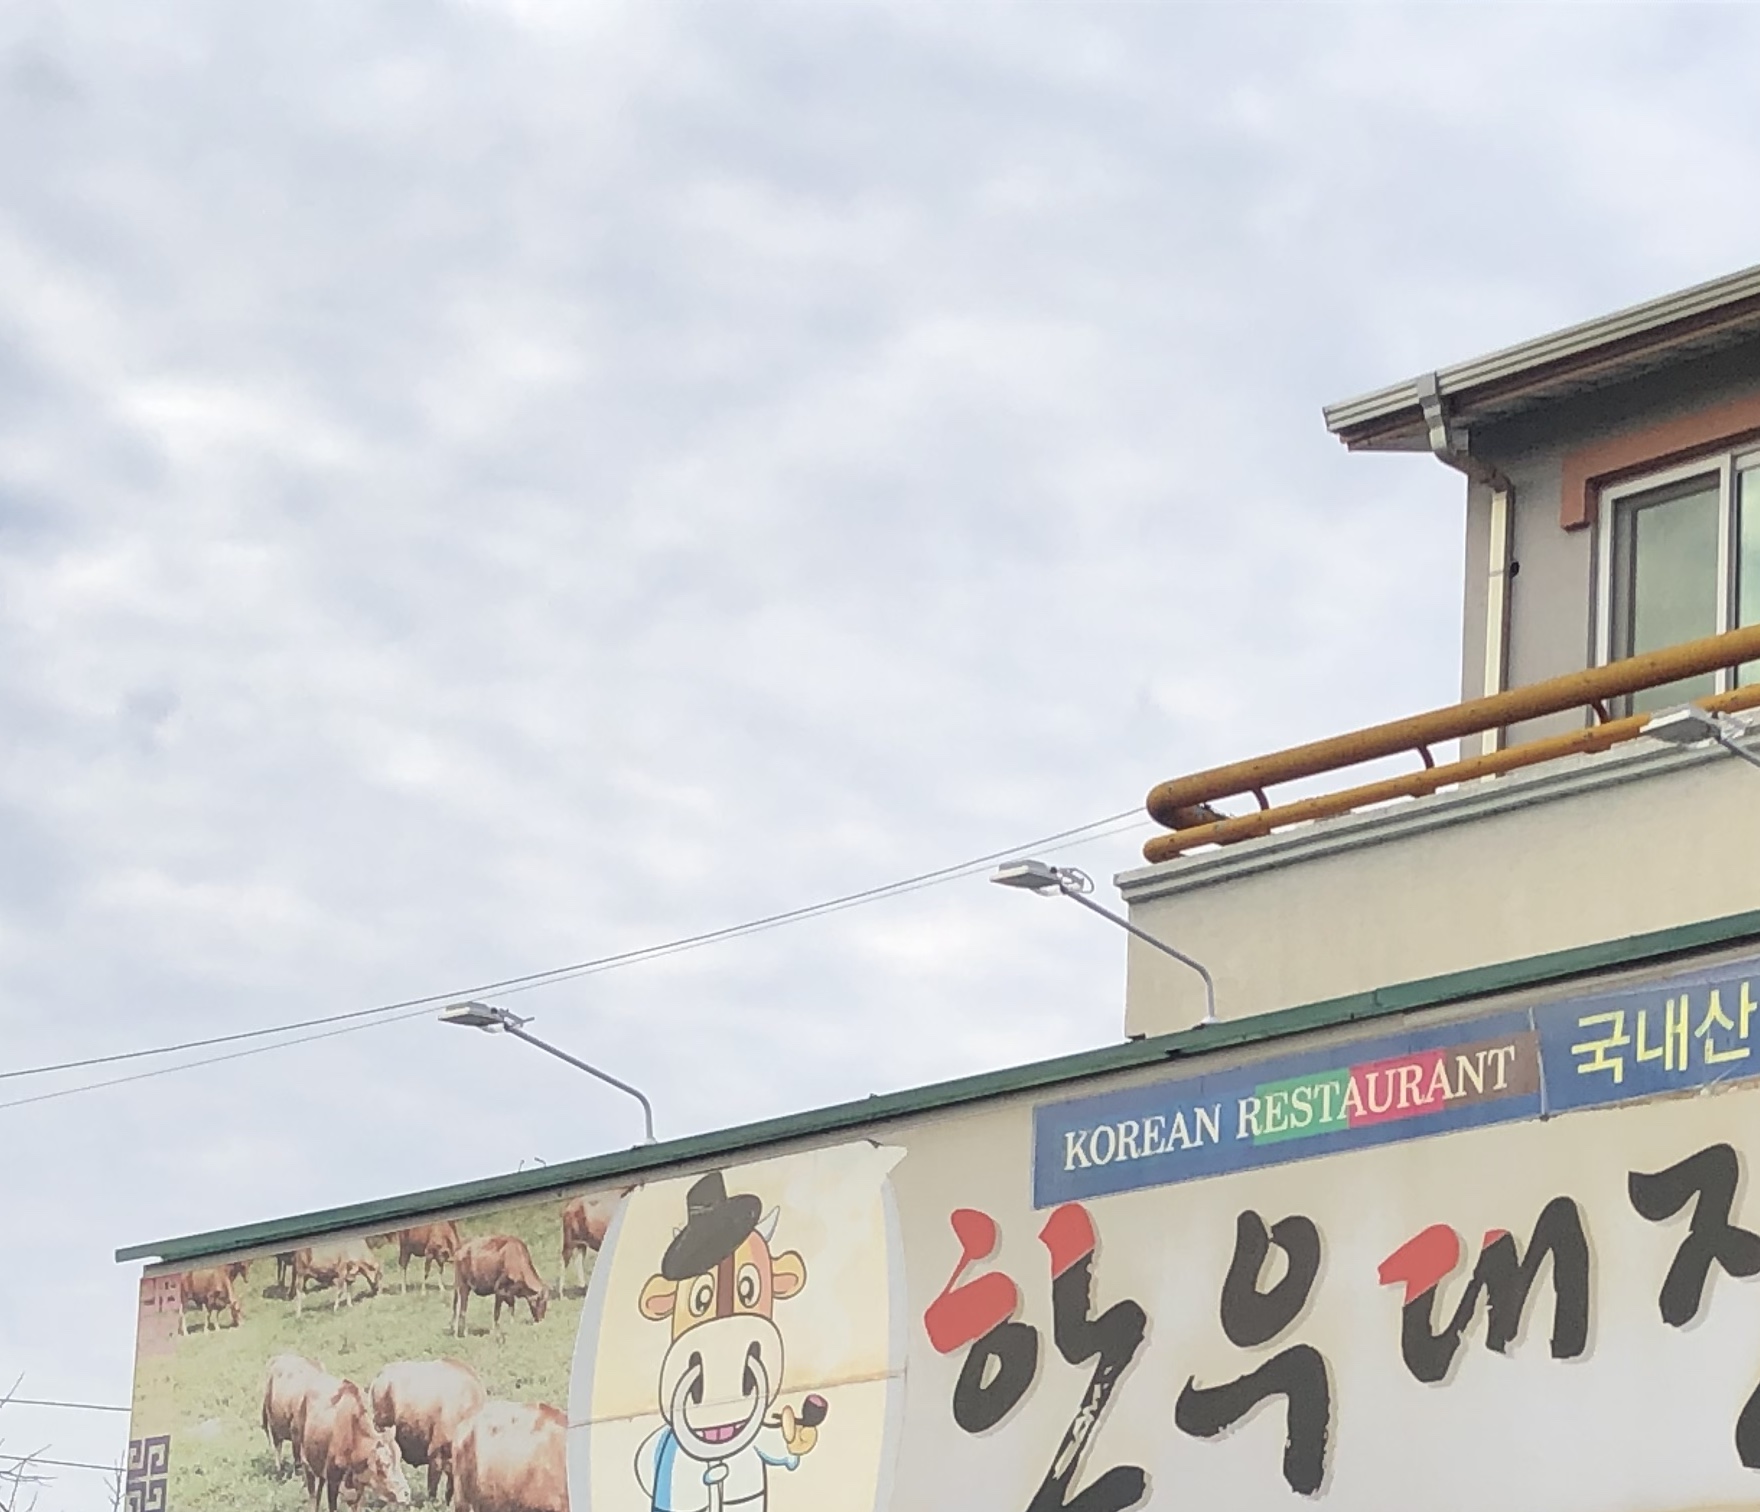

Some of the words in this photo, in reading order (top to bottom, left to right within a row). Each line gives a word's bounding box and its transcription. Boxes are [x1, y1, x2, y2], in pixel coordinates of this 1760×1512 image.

[1570, 981, 1758, 1084] 국내산
[1063, 1103, 1223, 1172] KOREAN
[1236, 1044, 1517, 1140] RESTAURANT
